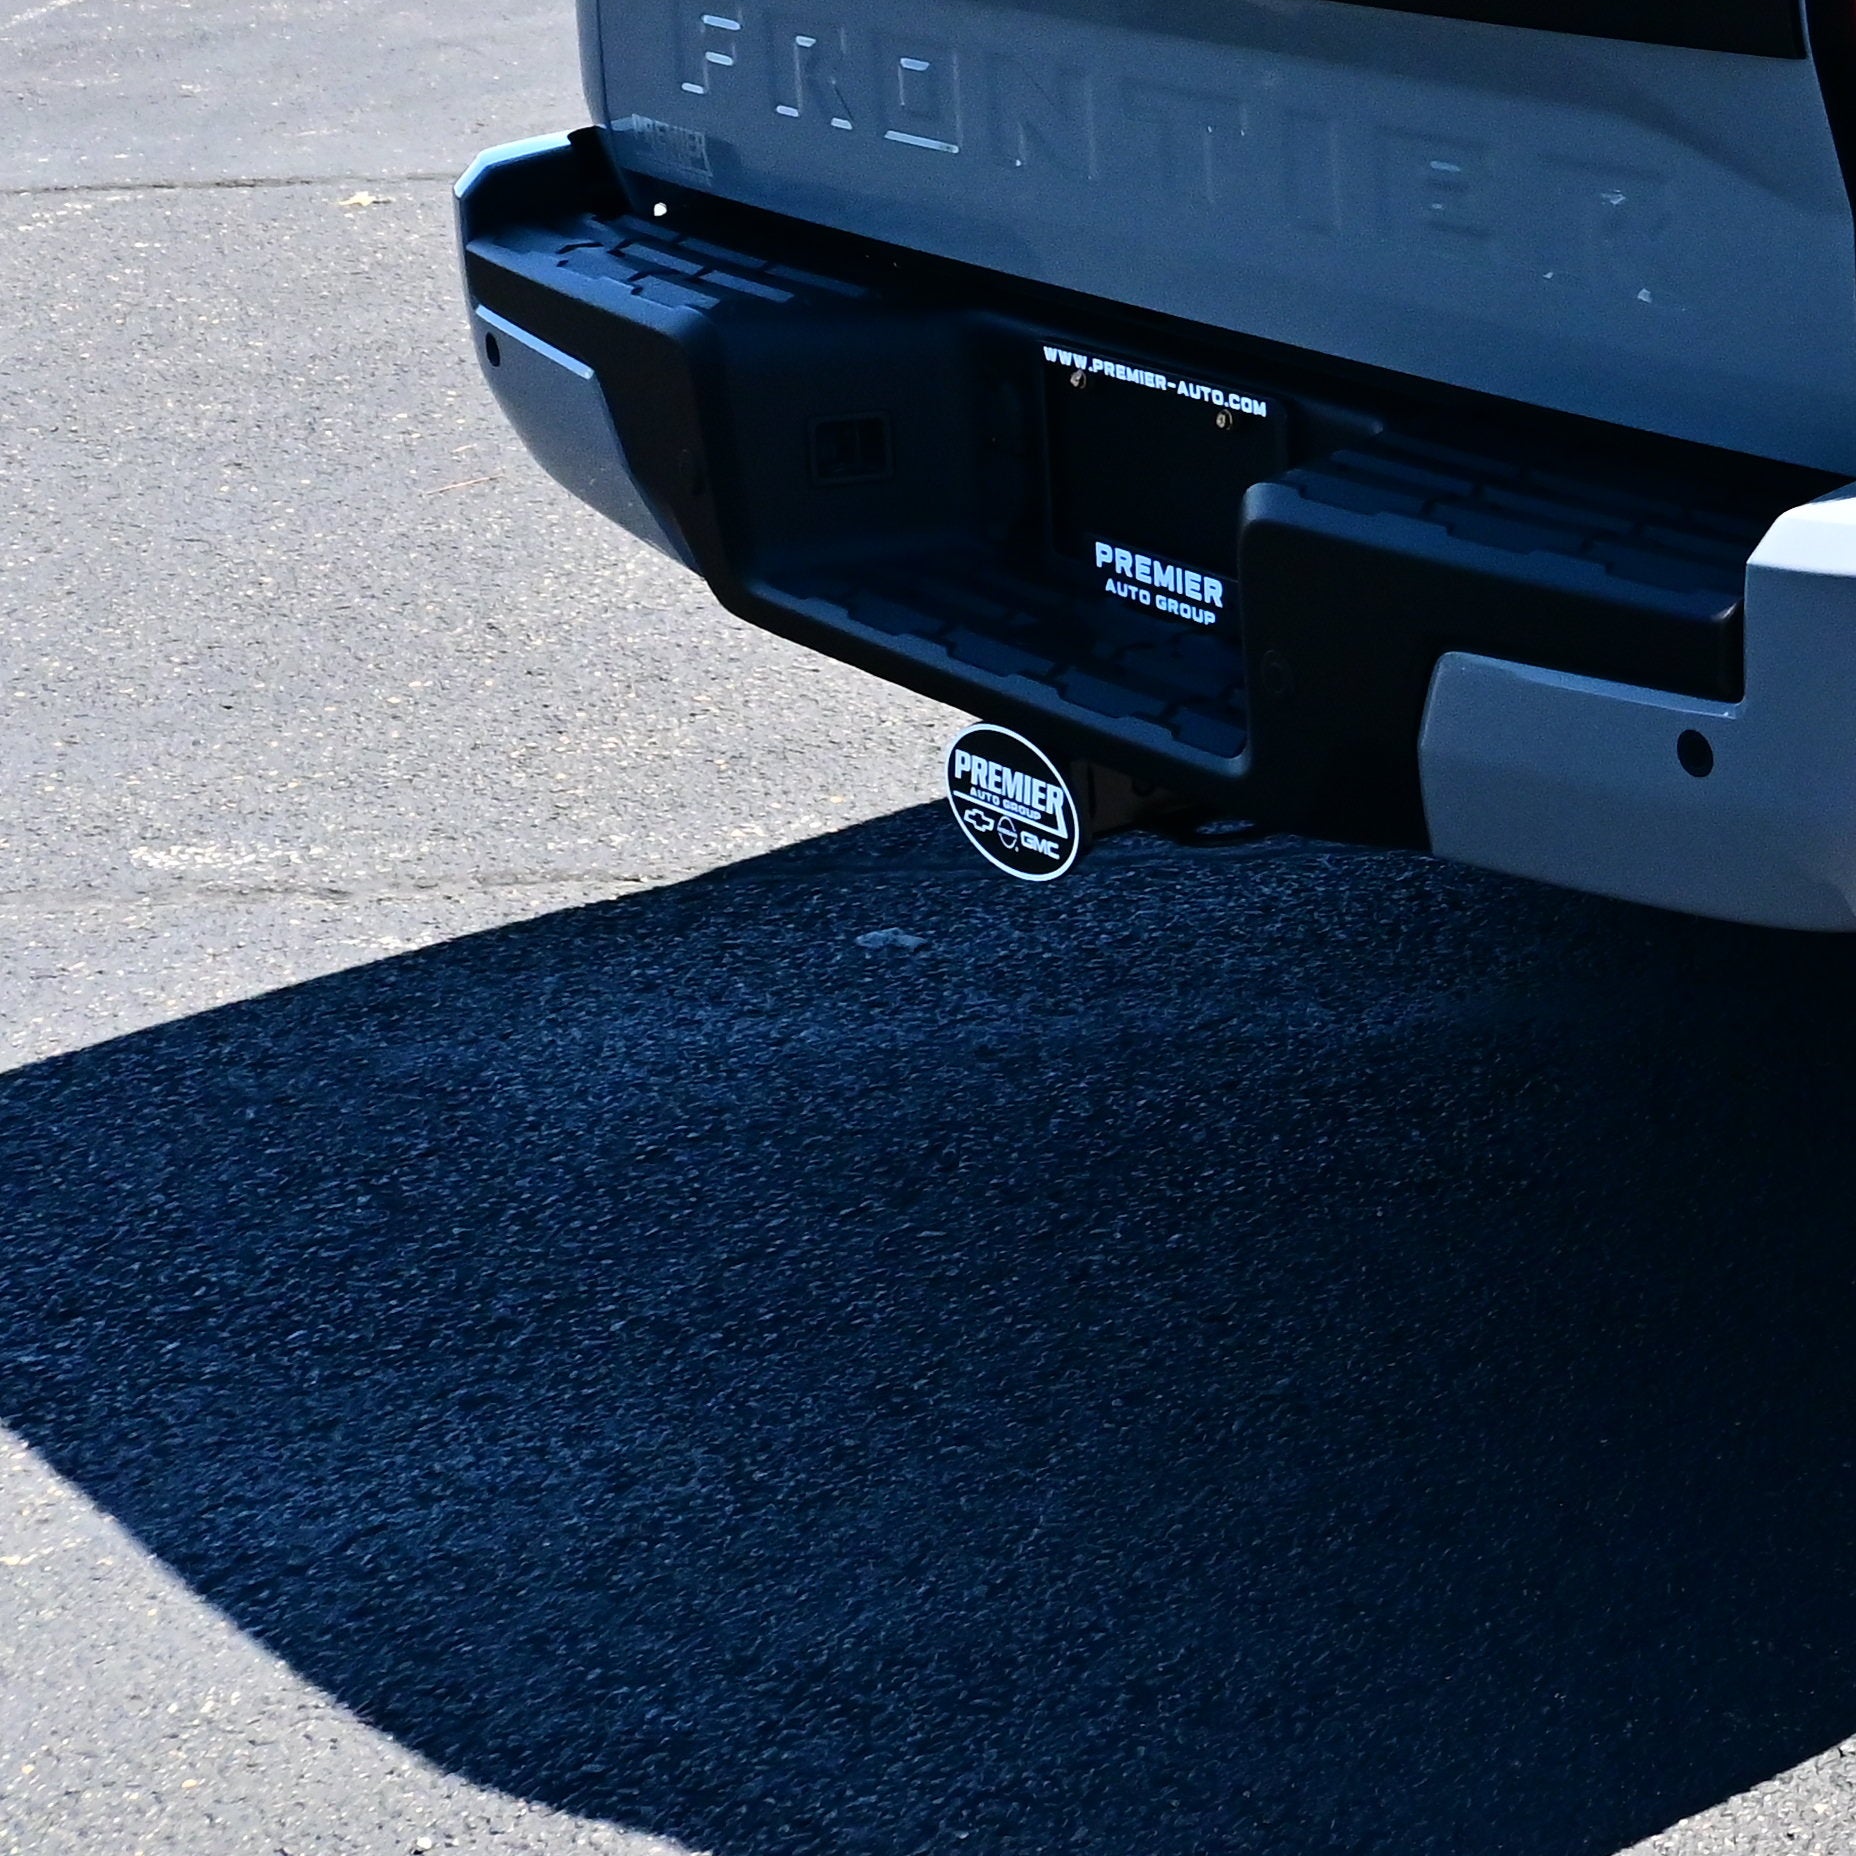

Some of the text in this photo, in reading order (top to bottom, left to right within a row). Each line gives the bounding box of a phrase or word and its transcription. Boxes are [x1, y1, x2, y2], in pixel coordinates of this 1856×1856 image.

[1043, 345, 1266, 417] WWW.PREMIER-AUTO.COM
[1095, 541, 1223, 608] PREMIER
[1105, 577, 1216, 625] AUTO GROUP
[954, 748, 1066, 816] PREMIER
[970, 786, 1041, 821] AUTO GROUP
[1020, 830, 1060, 860] GMC
